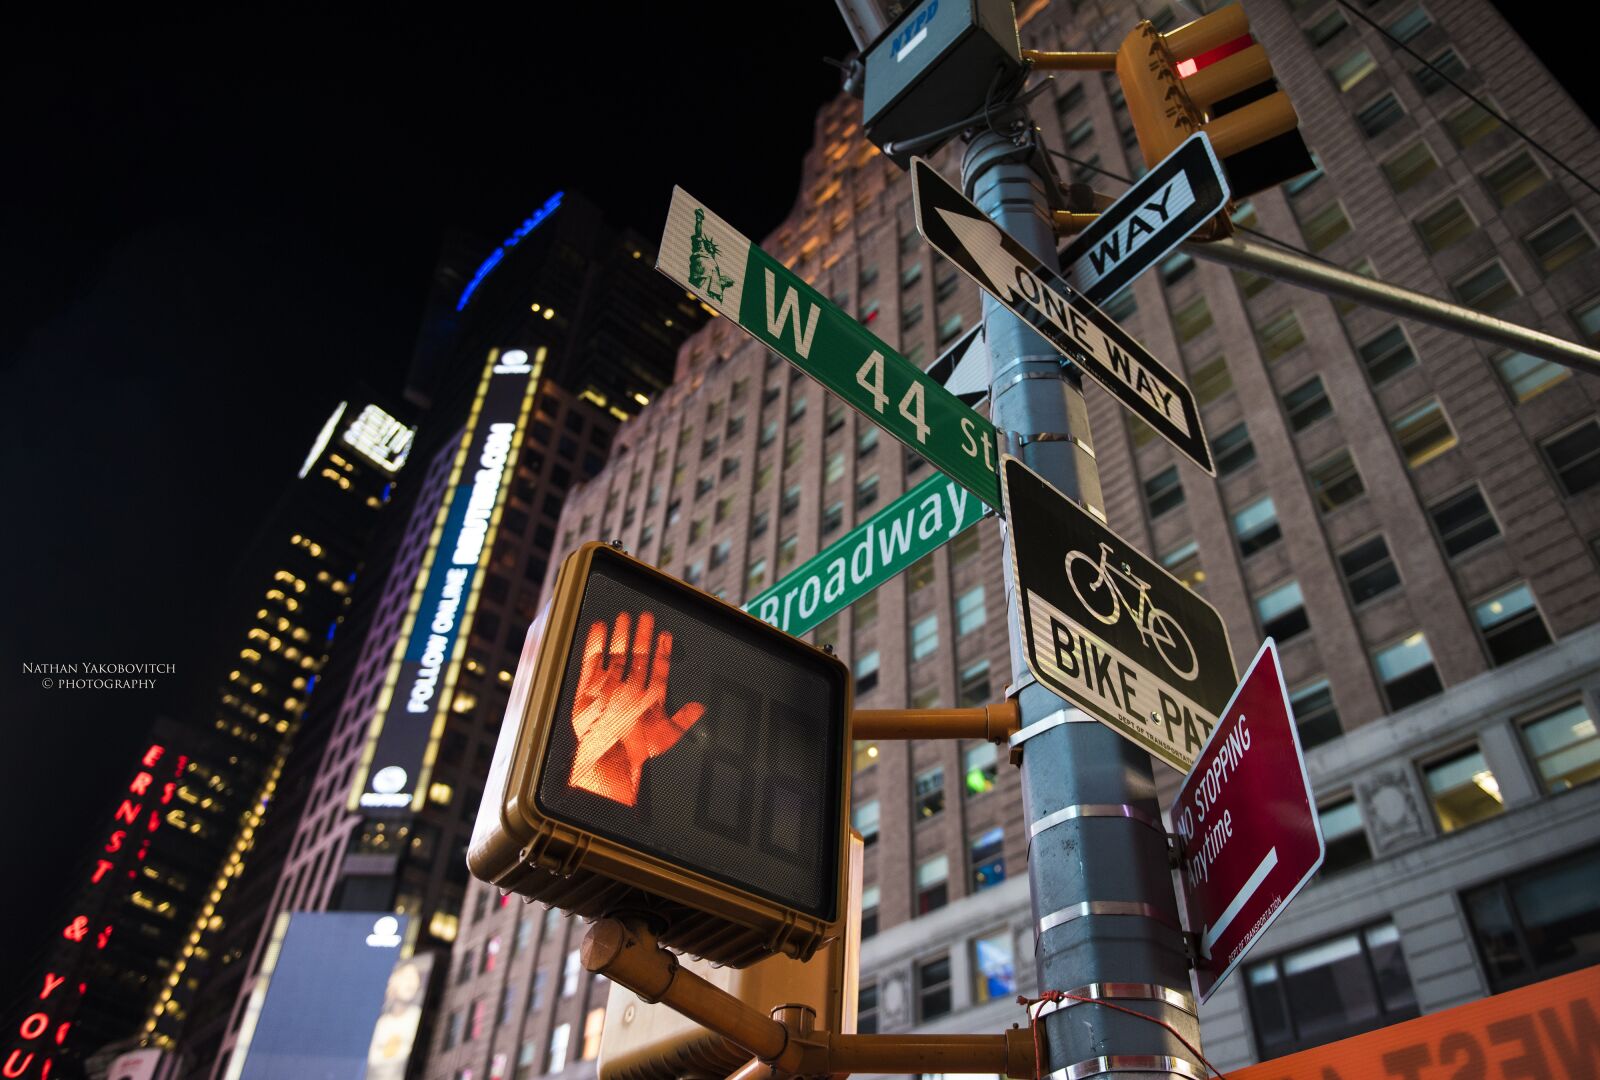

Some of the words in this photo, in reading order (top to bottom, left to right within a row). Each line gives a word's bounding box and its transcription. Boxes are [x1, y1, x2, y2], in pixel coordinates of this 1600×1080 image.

[890, 0, 939, 58] NYPD
[1088, 183, 1175, 274] WAY
[764, 267, 821, 360] W
[855, 349, 931, 445] 44
[960, 418, 995, 473] St
[1014, 265, 1095, 352] ONE
[1103, 336, 1173, 416] WAY
[760, 482, 968, 632] Broadway
[1050, 616, 1147, 725] BIKE
[1158, 688, 1214, 753] PAT
[1118, 714, 1135, 729] DEPT
[1136, 725, 1145, 735] OF
[1146, 731, 1194, 765] TRANSPORTATI
[91, 744, 165, 884] ERNST
[1178, 805, 1194, 846] NO
[1194, 713, 1252, 822] STOPPING
[1187, 809, 1233, 892] Anytime
[63, 915, 89, 942] &
[1228, 946, 1239, 963] DEPT
[1238, 939, 1245, 952] OF
[1243, 895, 1282, 944] TRANSPORTATION
